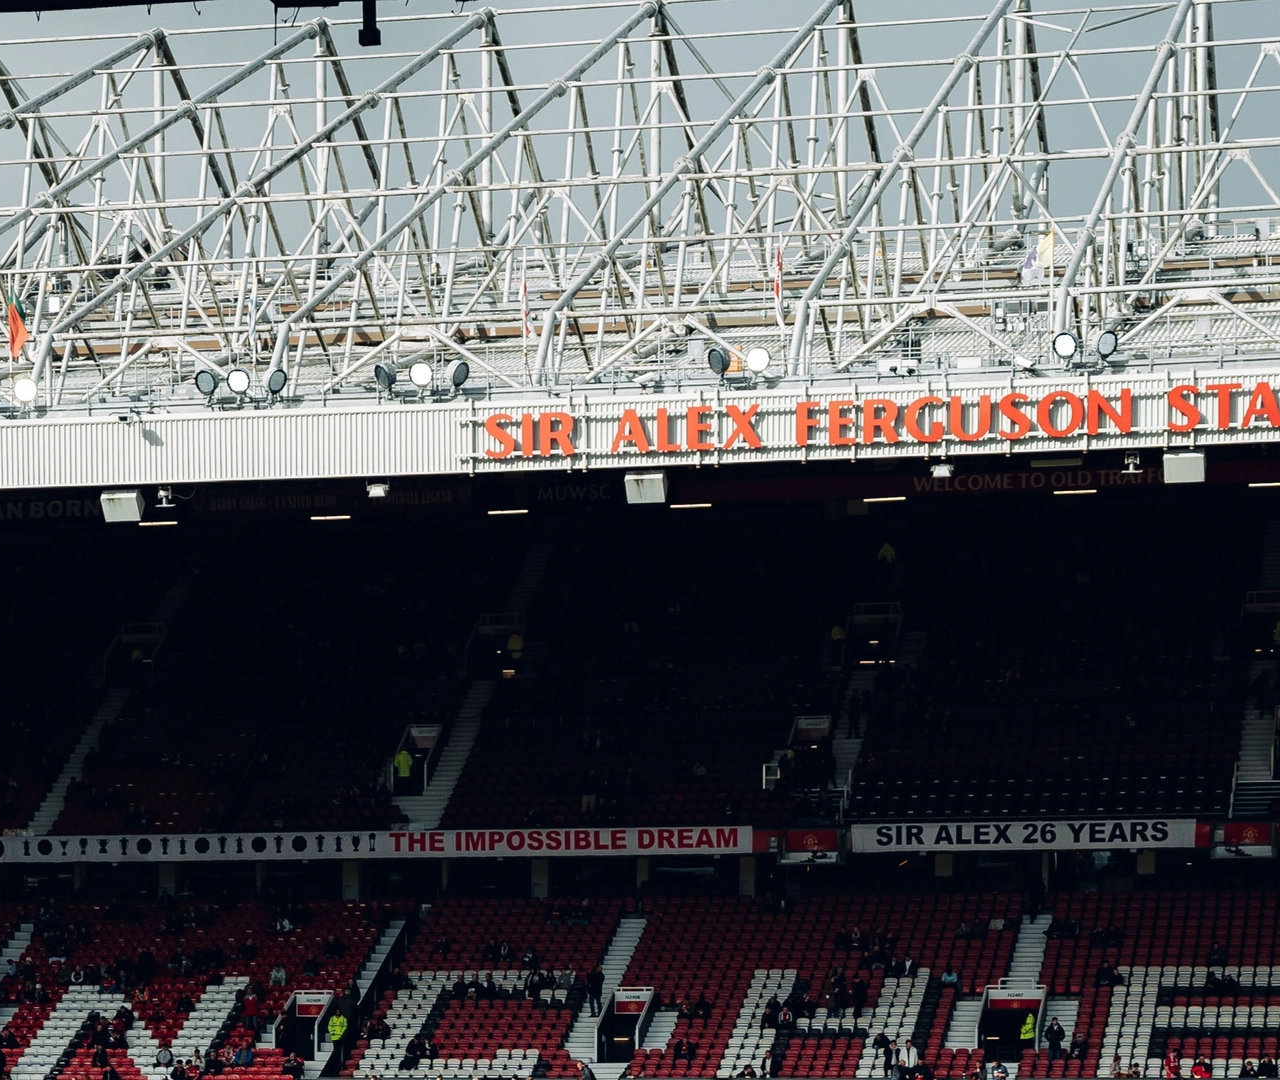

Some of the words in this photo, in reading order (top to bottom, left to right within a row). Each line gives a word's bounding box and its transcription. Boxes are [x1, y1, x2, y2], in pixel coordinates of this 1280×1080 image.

[484, 411, 575, 459] SIR
[610, 404, 762, 454] ALEX
[796, 387, 1131, 446] FERGUSON
[913, 473, 1013, 492] WELCOME
[1019, 473, 1045, 488] TO
[1050, 470, 1092, 487] OLD
[1097, 466, 1164, 485] TRAFF
[537, 484, 612, 502] MUWSC
[29, 499, 101, 519] BORN
[389, 831, 445, 852] THE
[455, 829, 627, 851] IMPOSSIBLE
[637, 827, 738, 849] DREAM
[876, 825, 924, 846] SIR
[934, 823, 1013, 845] ALEX
[1022, 822, 1057, 844] 26
[1067, 821, 1169, 843] YEARS
